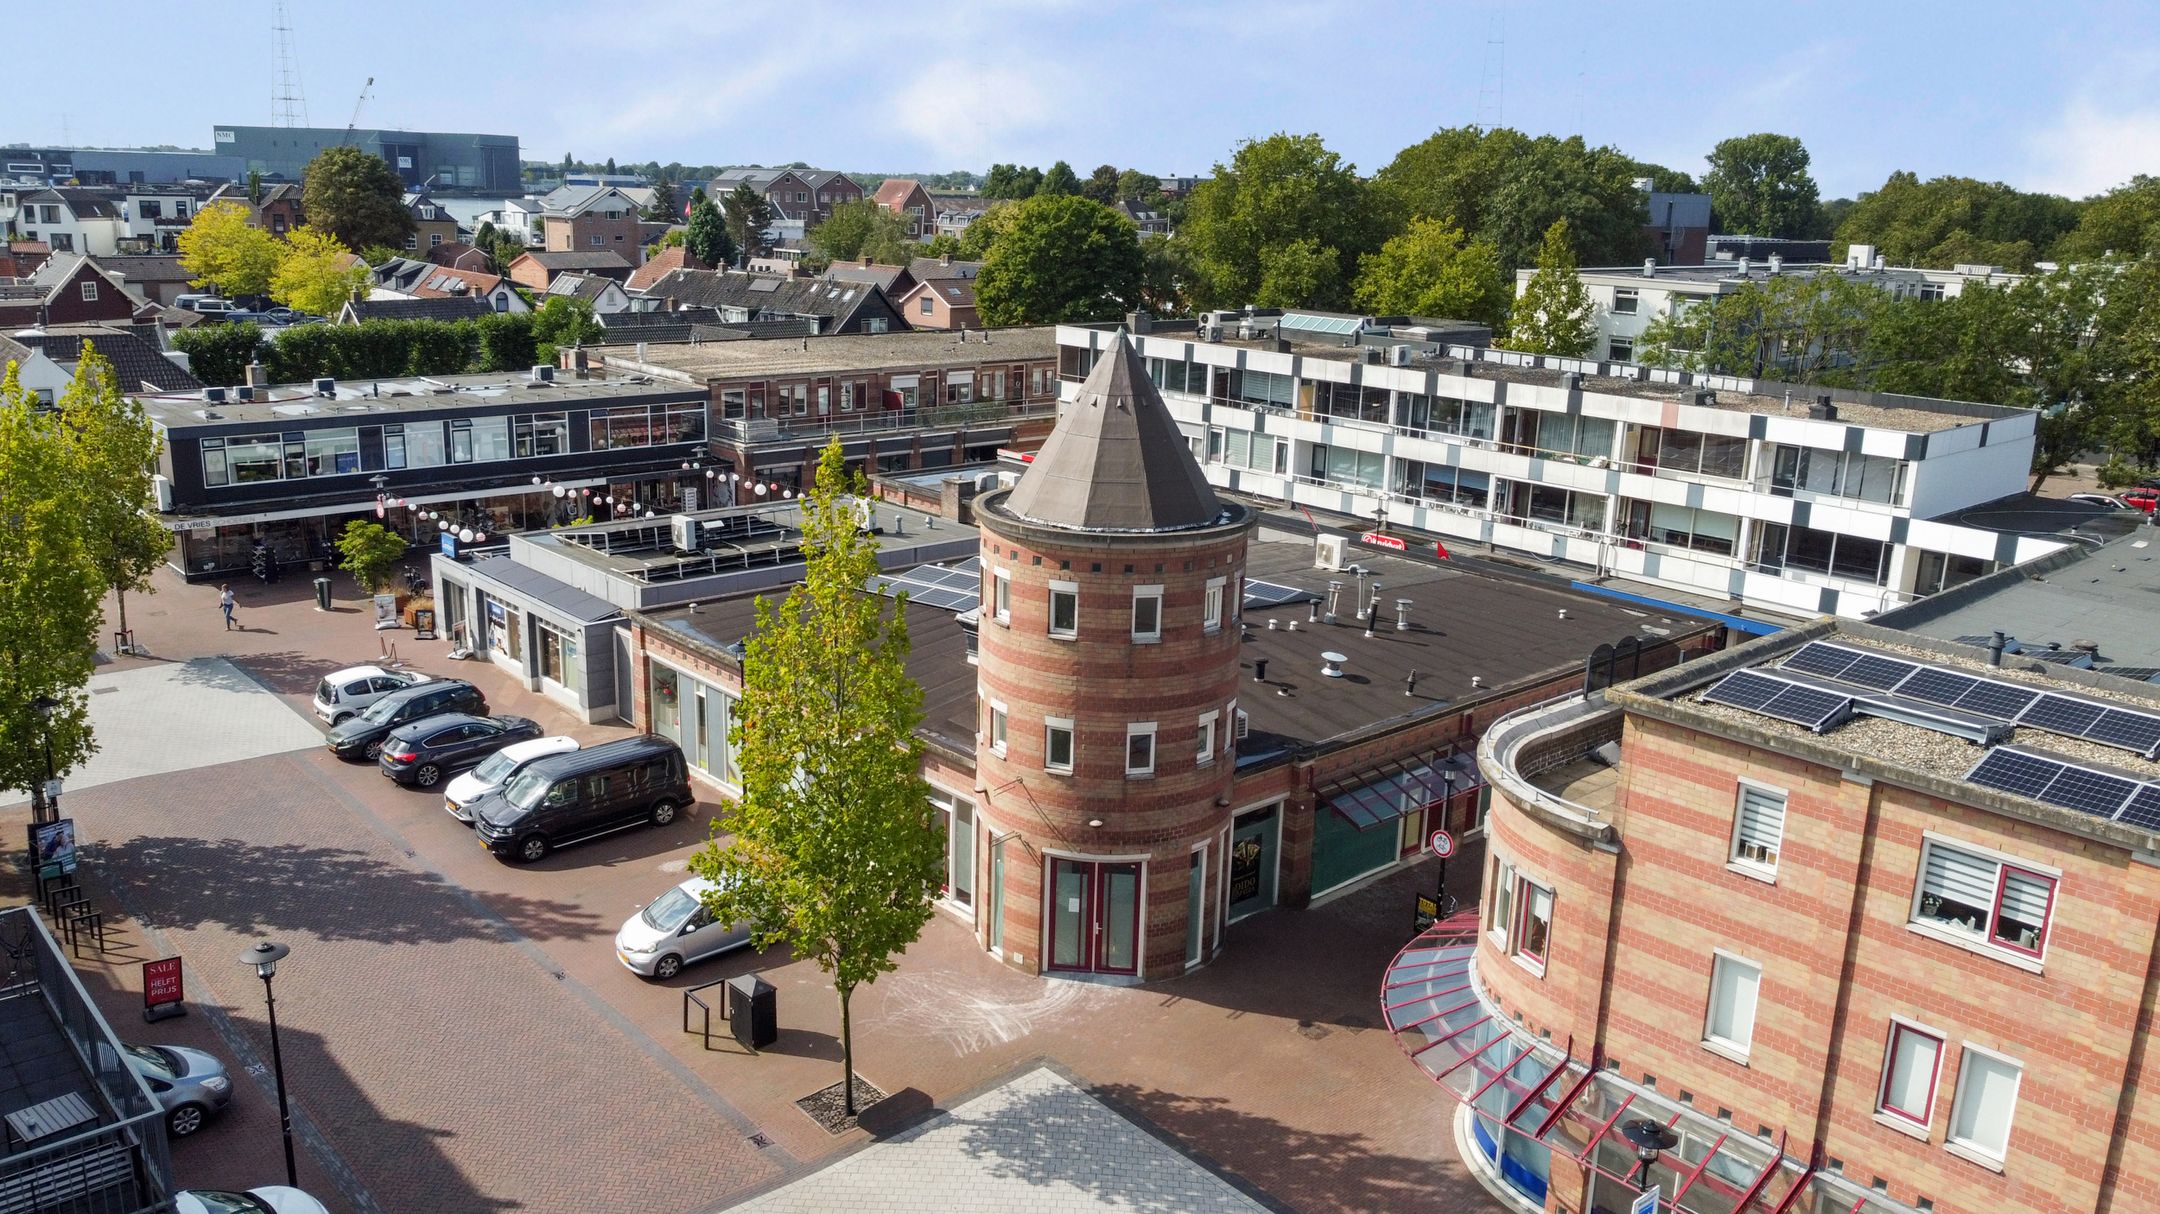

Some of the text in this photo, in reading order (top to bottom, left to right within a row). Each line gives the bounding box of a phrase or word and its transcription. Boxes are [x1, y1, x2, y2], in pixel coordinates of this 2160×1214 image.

[187, 520, 211, 529] VRIES
[150, 962, 176, 975] SALE
[150, 976, 176, 988] HELFT
[151, 985, 177, 997] PRIJS
